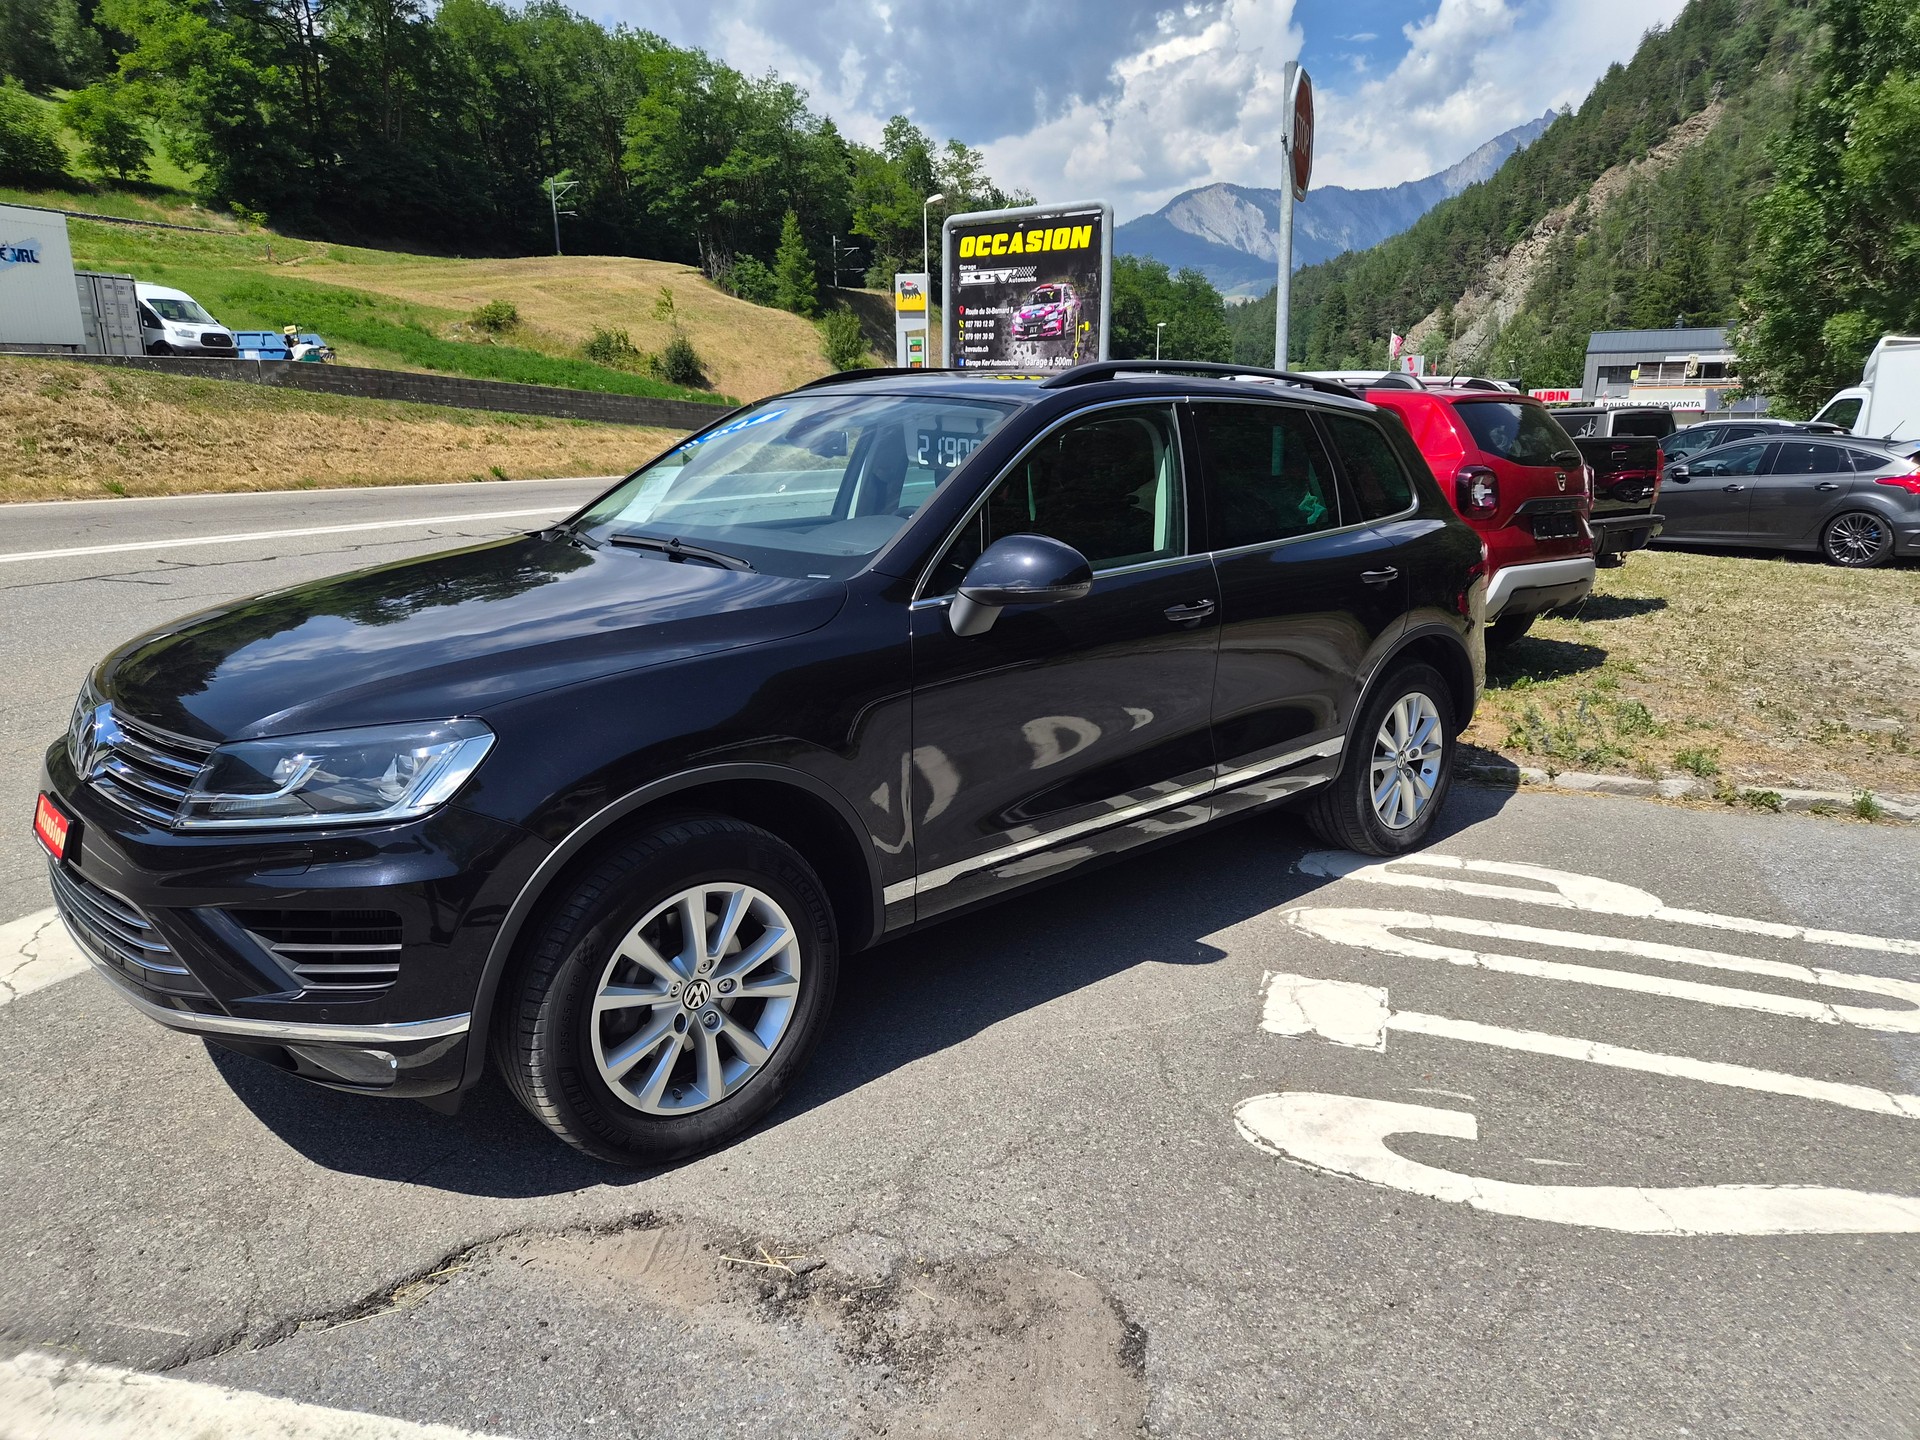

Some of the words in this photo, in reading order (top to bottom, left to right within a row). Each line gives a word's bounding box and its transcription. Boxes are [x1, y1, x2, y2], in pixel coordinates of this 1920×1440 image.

[1295, 112, 1309, 157] STOP
[958, 225, 1093, 258] OCCASION
[965, 359, 981, 368] Garage
[1024, 357, 1048, 368] Garage
[1054, 356, 1072, 367] 500m
[38, 799, 66, 851] Occasion
